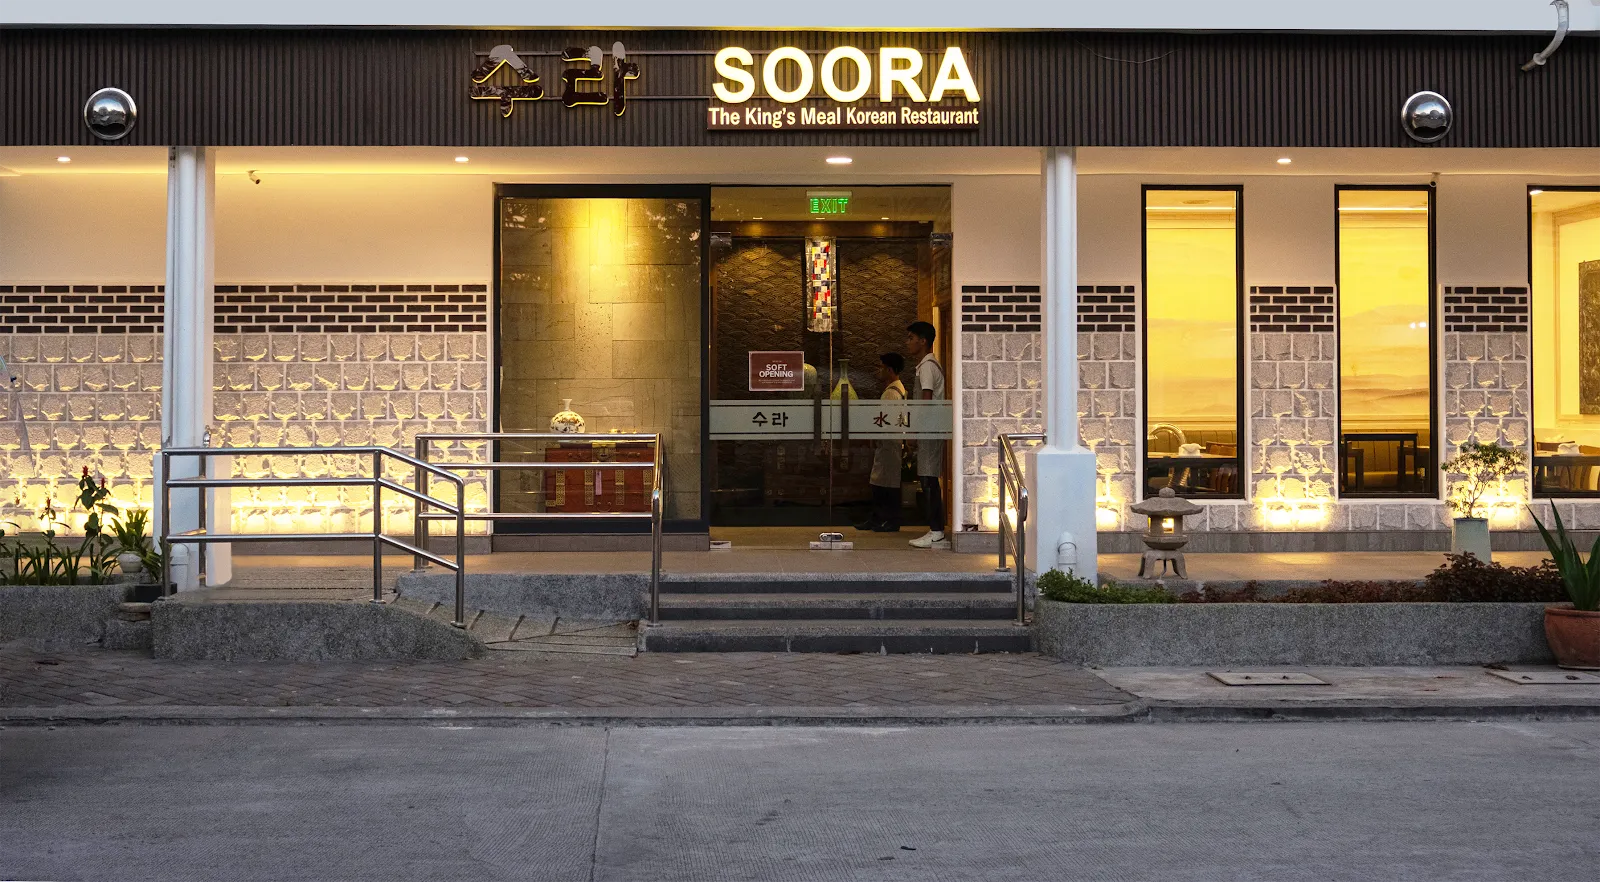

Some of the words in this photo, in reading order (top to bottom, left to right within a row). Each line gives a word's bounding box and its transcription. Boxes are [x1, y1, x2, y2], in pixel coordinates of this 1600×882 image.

[469, 41, 641, 118] 수라
[712, 46, 981, 103] SOORA
[708, 107, 741, 126] The
[745, 107, 796, 128] King’s
[801, 107, 841, 126] Meal
[846, 107, 897, 125] Korean
[901, 106, 979, 125] Restaurant
[809, 198, 849, 214] EXIT
[758, 370, 794, 378] OPENING
[766, 363, 788, 371] SOFT
[751, 411, 789, 428] 수라
